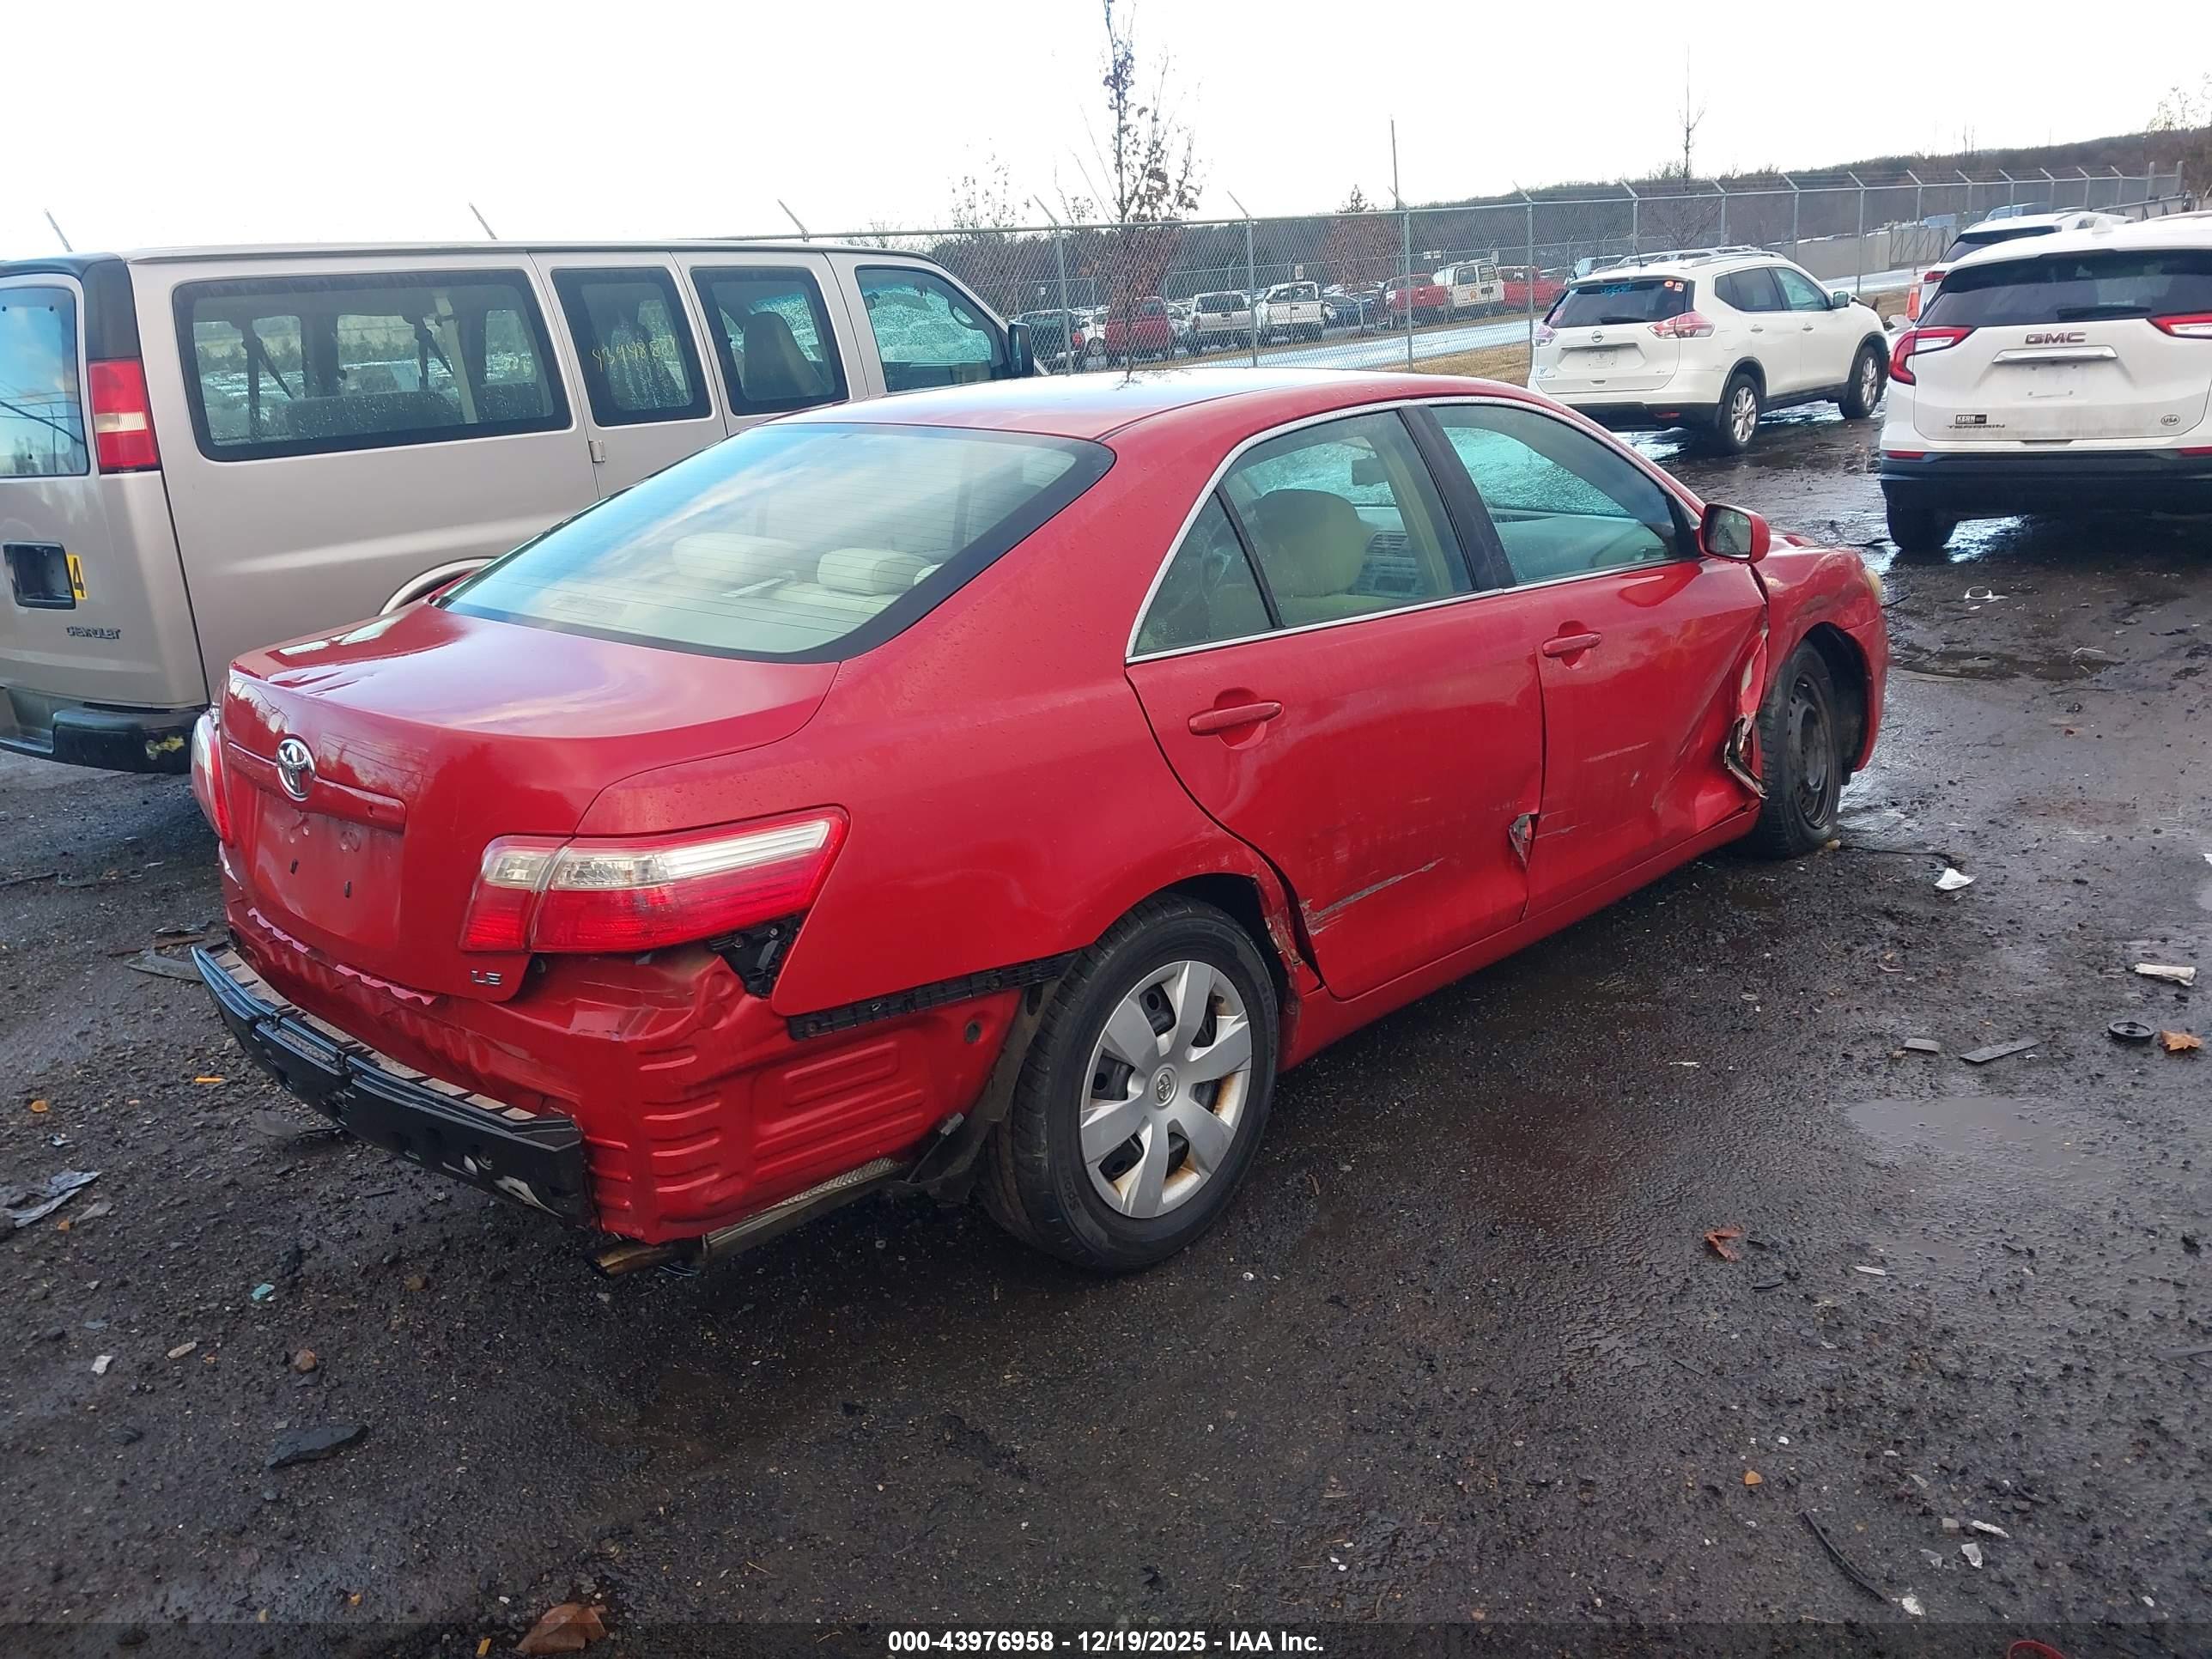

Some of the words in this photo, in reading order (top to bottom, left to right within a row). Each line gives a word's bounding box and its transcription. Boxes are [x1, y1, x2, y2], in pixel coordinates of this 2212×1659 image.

[2025, 331, 2087, 344] GMC
[72, 557, 86, 599] 4
[471, 969, 502, 986] LE
